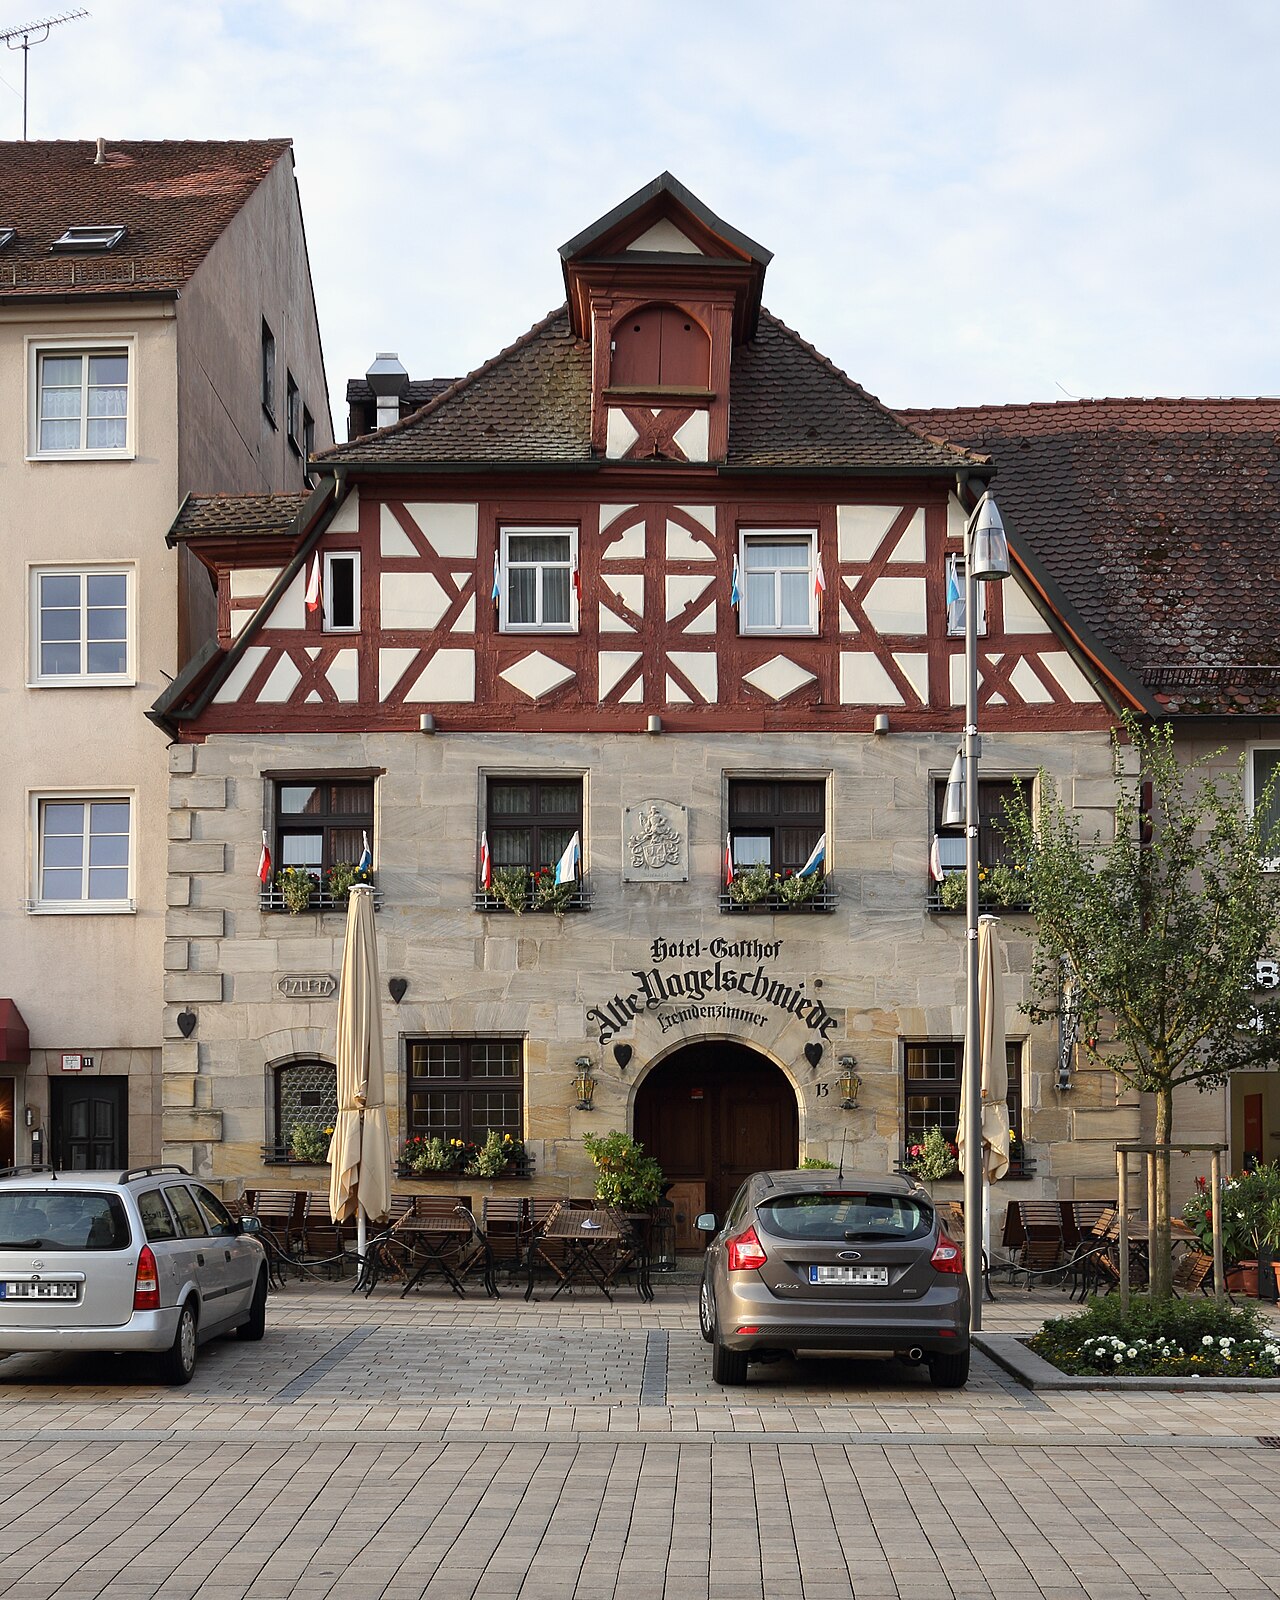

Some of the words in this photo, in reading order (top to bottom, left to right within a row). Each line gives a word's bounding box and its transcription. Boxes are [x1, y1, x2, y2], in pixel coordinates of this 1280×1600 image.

[586, 990, 645, 1046] Alte
[631, 960, 838, 1044] Nagelschmiede
[657, 1001, 768, 1034] Fremdenzimmer
[815, 1083, 828, 1098] 13
